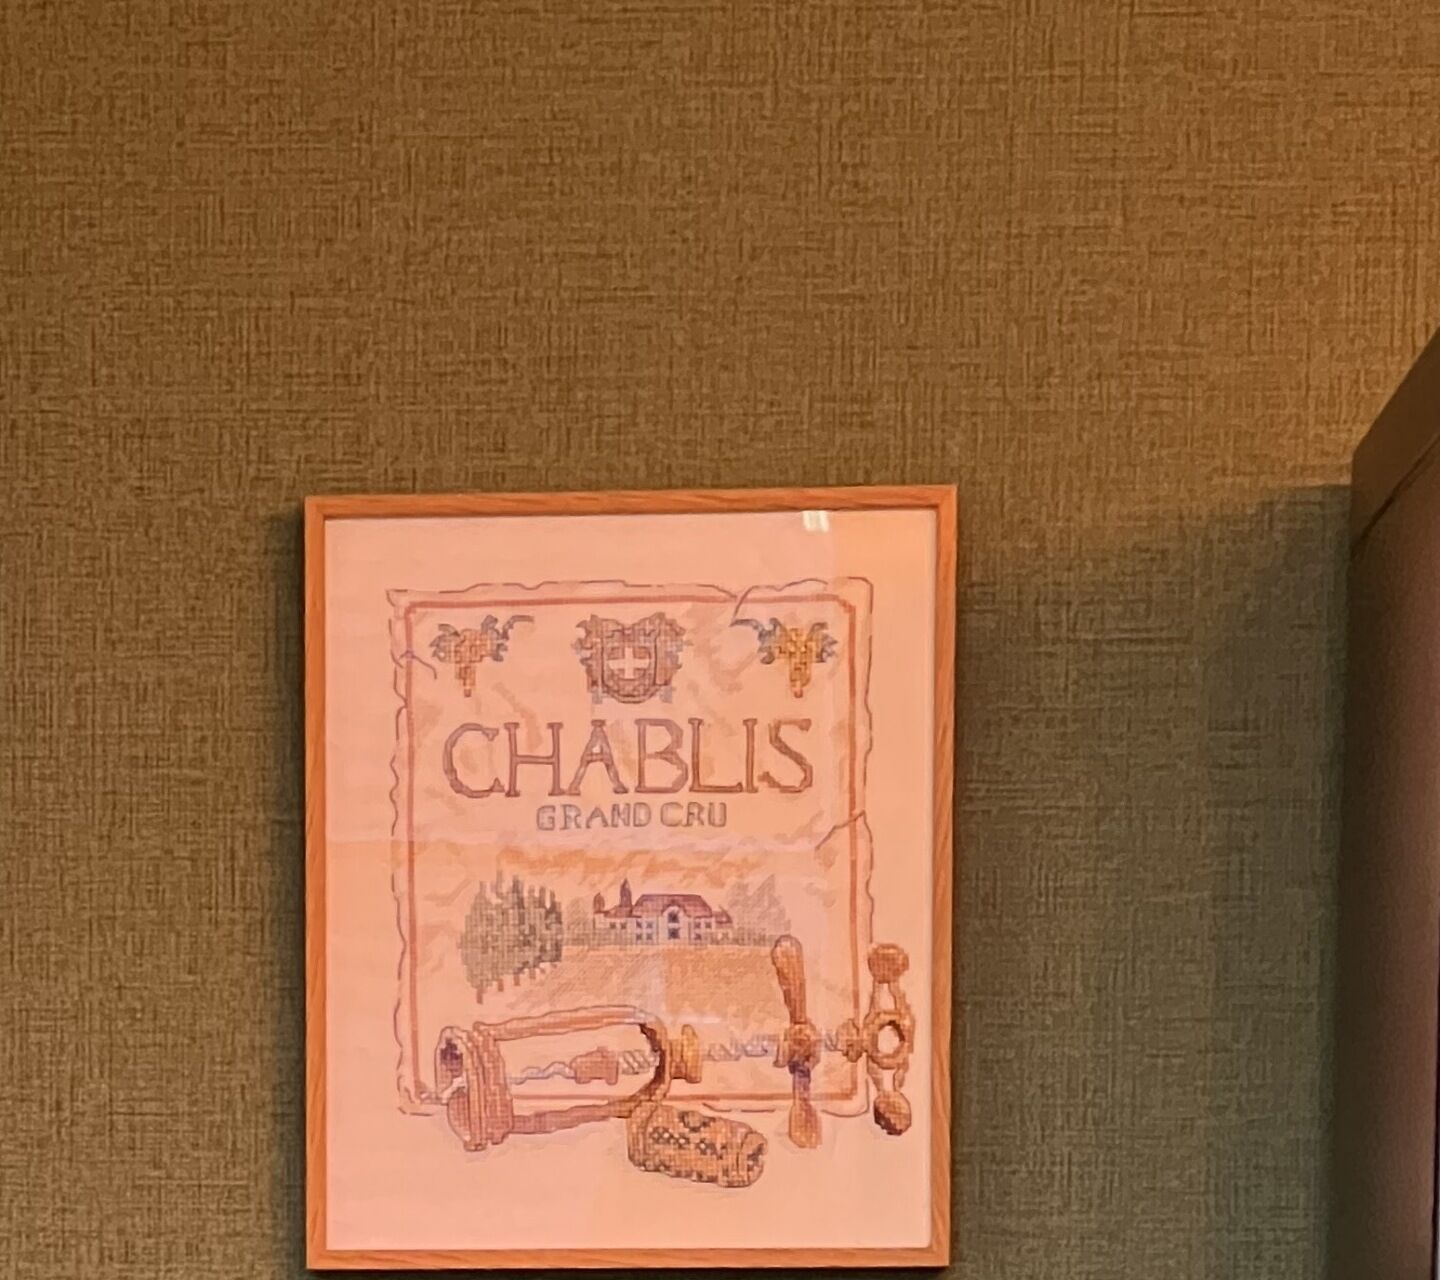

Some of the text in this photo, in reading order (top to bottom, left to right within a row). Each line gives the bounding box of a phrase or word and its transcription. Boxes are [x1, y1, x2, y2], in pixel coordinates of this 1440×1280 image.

[442, 718, 813, 798] CHABLIS
[536, 802, 727, 830] GRAND CRU
